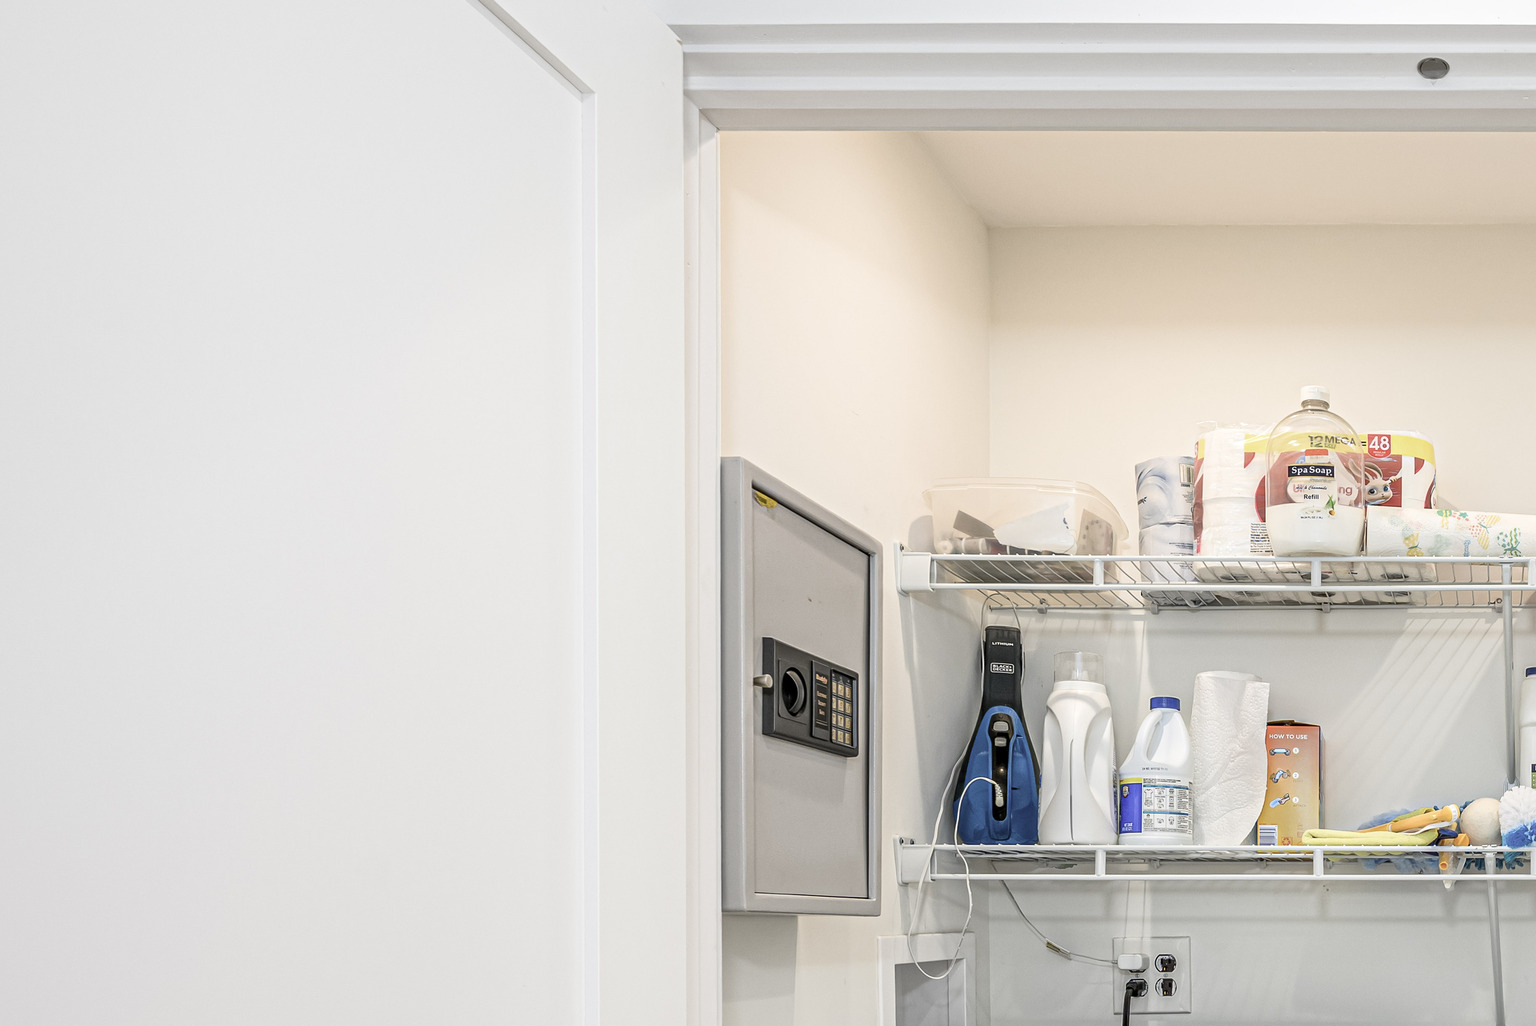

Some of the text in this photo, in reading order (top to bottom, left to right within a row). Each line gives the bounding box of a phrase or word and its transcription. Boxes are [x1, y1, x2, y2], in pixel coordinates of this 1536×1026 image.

[1308, 435, 1323, 448] 12
[1369, 435, 1390, 450] 48
[1291, 466, 1308, 476] Spa
